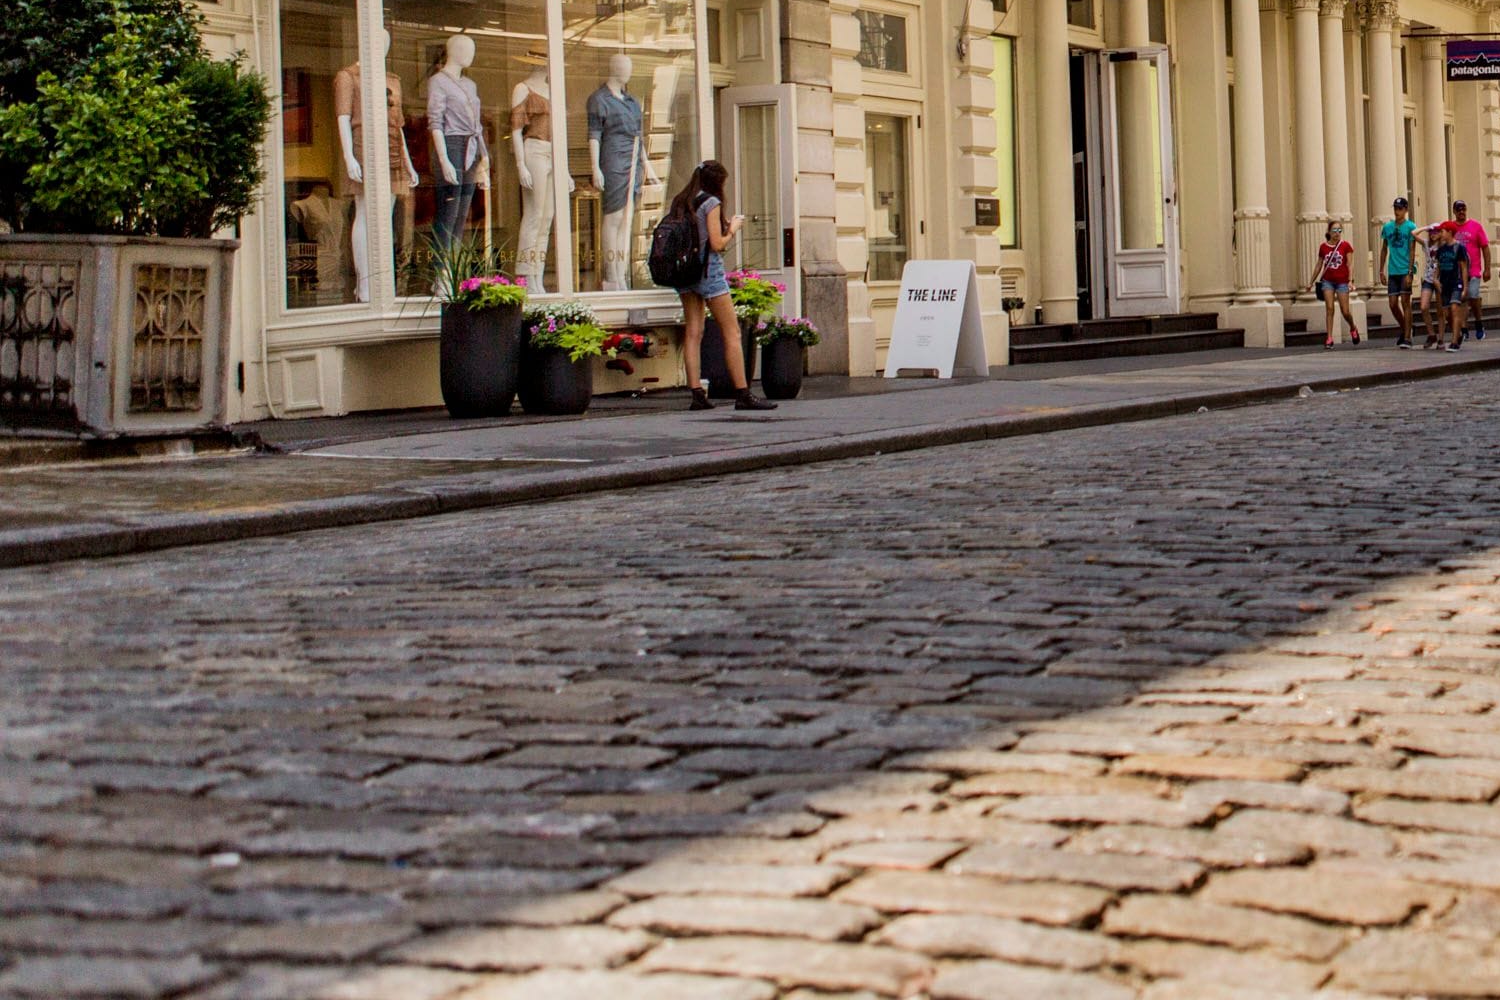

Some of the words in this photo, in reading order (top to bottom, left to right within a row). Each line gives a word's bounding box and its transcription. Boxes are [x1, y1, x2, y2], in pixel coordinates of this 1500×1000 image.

[1450, 64, 1500, 77] patagonia
[907, 289, 929, 302] THE
[931, 289, 958, 302] LINE
